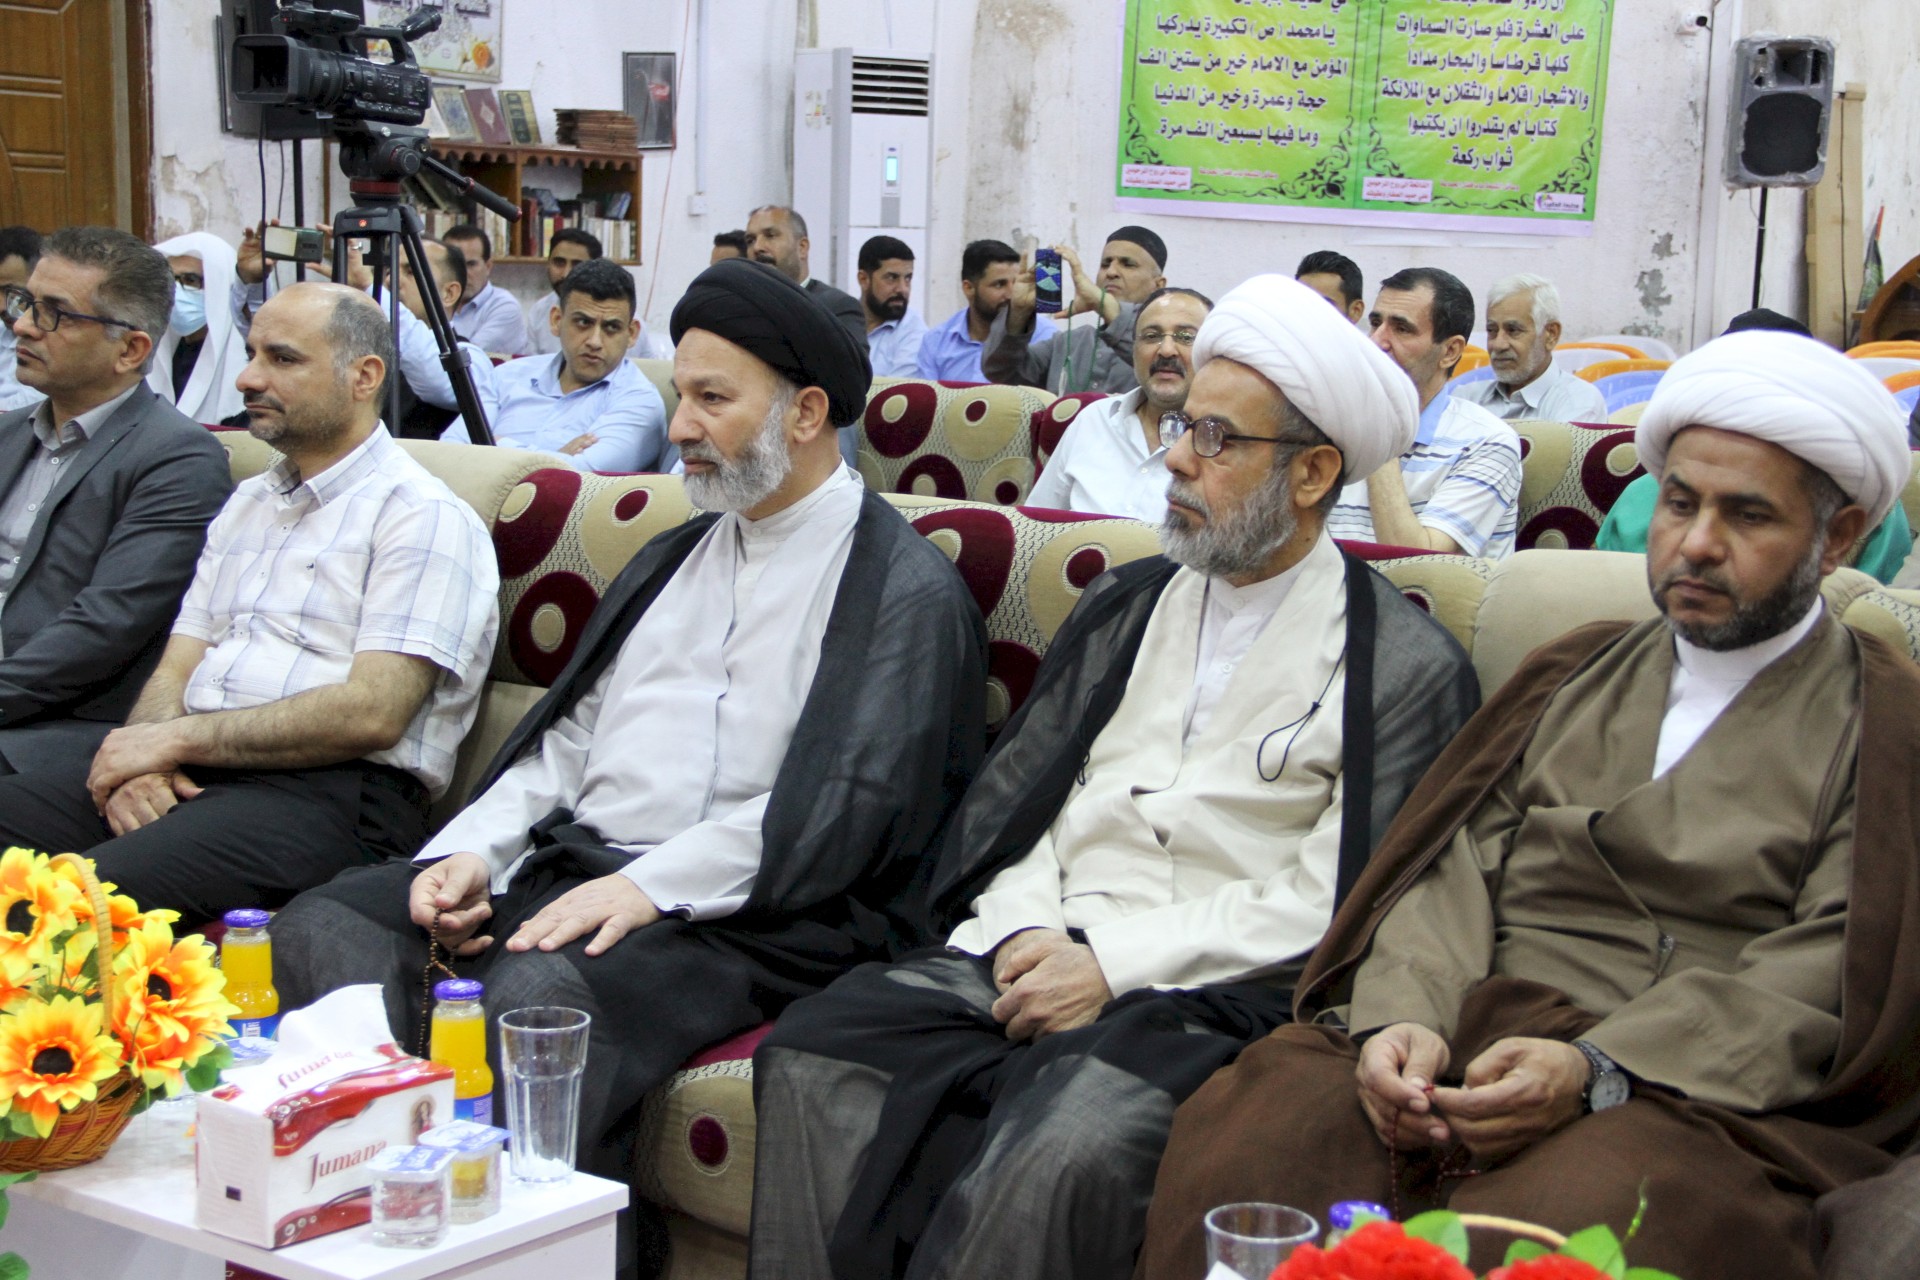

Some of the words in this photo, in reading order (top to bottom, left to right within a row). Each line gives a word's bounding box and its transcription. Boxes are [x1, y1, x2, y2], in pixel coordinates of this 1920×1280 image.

[1156, 14, 1202, 38] يدركها
[1203, 16, 1247, 39] تكبيرة
[1396, 14, 1454, 38] السماوات
[1455, 17, 1492, 39] صارت
[1493, 18, 1513, 42] فلو
[1516, 18, 1558, 43] العشرة
[1560, 23, 1585, 45] على
[1138, 47, 1167, 65] الف
[1169, 50, 1201, 73] ستين
[1203, 52, 1221, 73] من
[1223, 52, 1248, 76] خير
[1250, 55, 1289, 73] الامام
[1438, 51, 1488, 74] والبحار
[1545, 53, 1570, 77] كلها
[1291, 61, 1308, 79] مع
[1310, 58, 1347, 79] المؤمن
[1154, 84, 1195, 105] الدنيا
[1198, 87, 1215, 107] من
[1217, 87, 1250, 110] وخير
[1252, 88, 1294, 112] وعمرة
[1297, 89, 1327, 113] حجة
[1425, 85, 1441, 107] مع
[1442, 80, 1494, 107] والثقلان
[1533, 84, 1589, 111] والاشجار
[1185, 119, 1214, 137] الف
[1216, 122, 1263, 145] بسبعين
[1267, 124, 1294, 146] فيها
[1407, 113, 1447, 138] يكتبوا
[1465, 115, 1505, 141] يقدروا
[1506, 118, 1521, 140] لم
[1298, 127, 1319, 148] وما
[1481, 144, 1514, 172] ثواب
